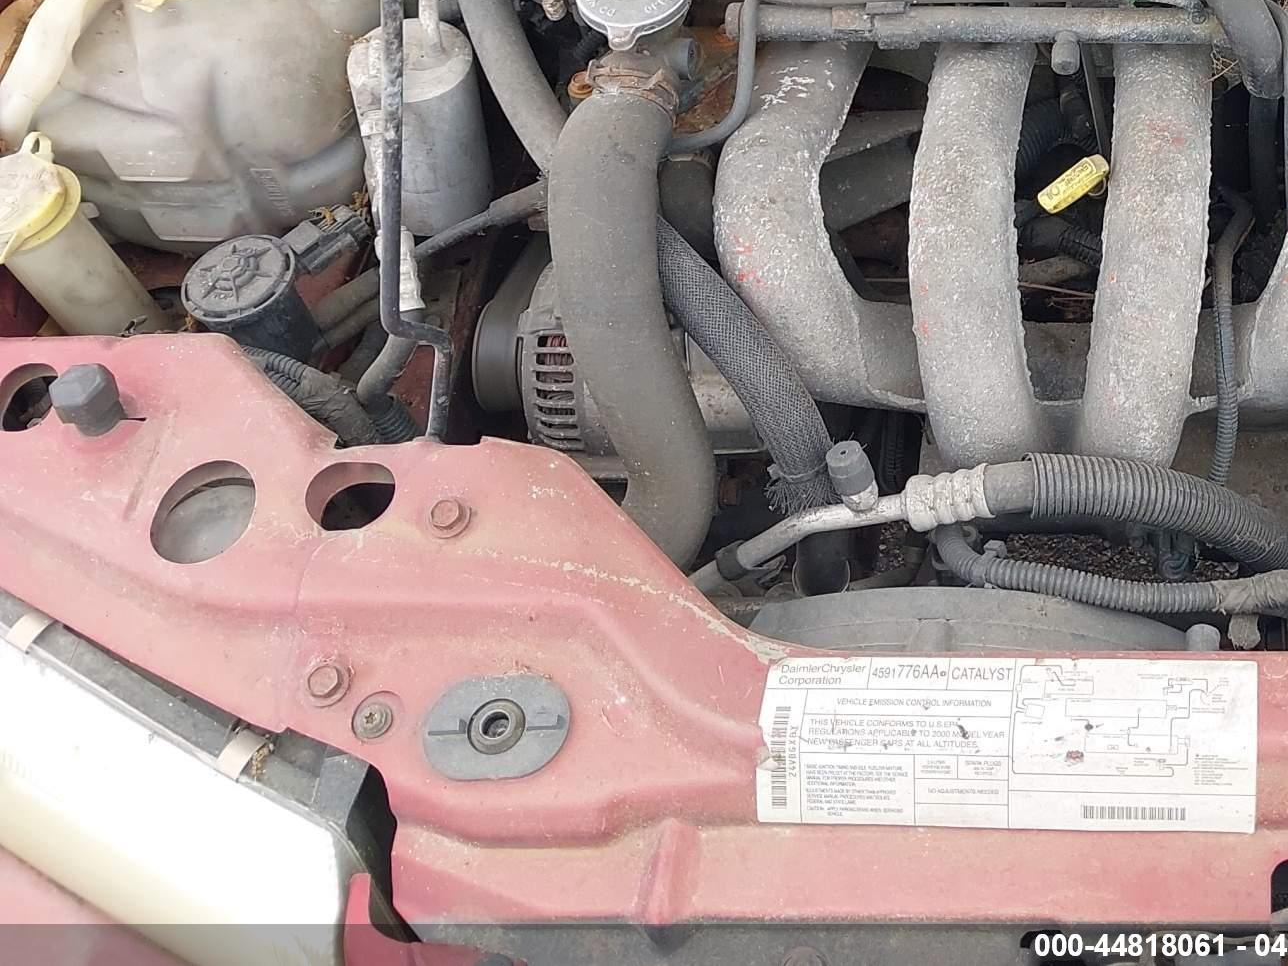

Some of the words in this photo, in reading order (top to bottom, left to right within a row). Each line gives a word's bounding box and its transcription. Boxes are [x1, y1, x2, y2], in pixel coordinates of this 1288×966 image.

[781, 664, 868, 675] DaimlerChrysler
[951, 666, 1013, 681] CATALYST
[778, 675, 842, 686] Corporation
[836, 697, 868, 706] VEHICLE
[869, 698, 904, 707] EMISSION
[905, 698, 941, 707] CONTROL
[942, 699, 992, 708] INFORMATION
[810, 718, 829, 727] THIS
[866, 719, 914, 728] CONFORMS
[919, 729, 931, 738] TO
[982, 731, 1005, 739] YEAR
